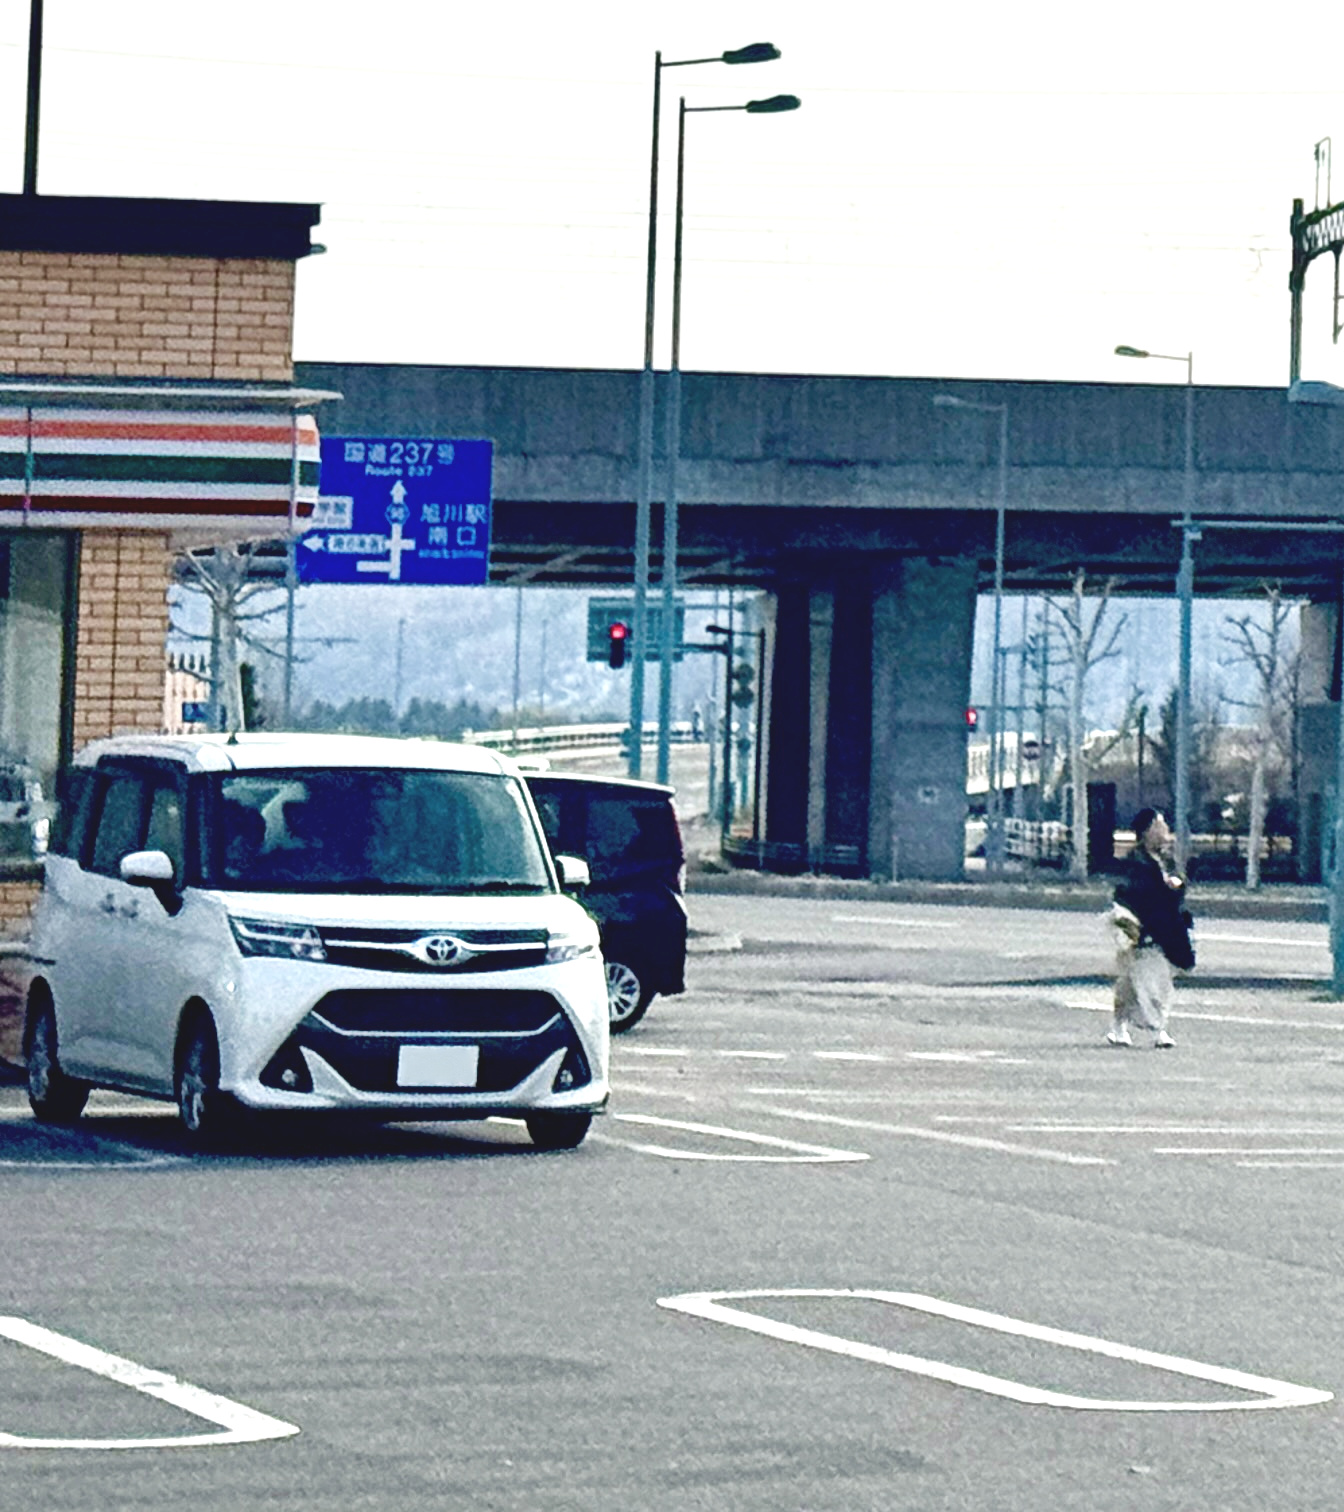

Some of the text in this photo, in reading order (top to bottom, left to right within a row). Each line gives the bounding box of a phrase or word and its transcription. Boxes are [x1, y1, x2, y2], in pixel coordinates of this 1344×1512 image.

[344, 441, 455, 465] 国道237号
[365, 464, 403, 477] Route
[420, 503, 487, 524] 旭川駅
